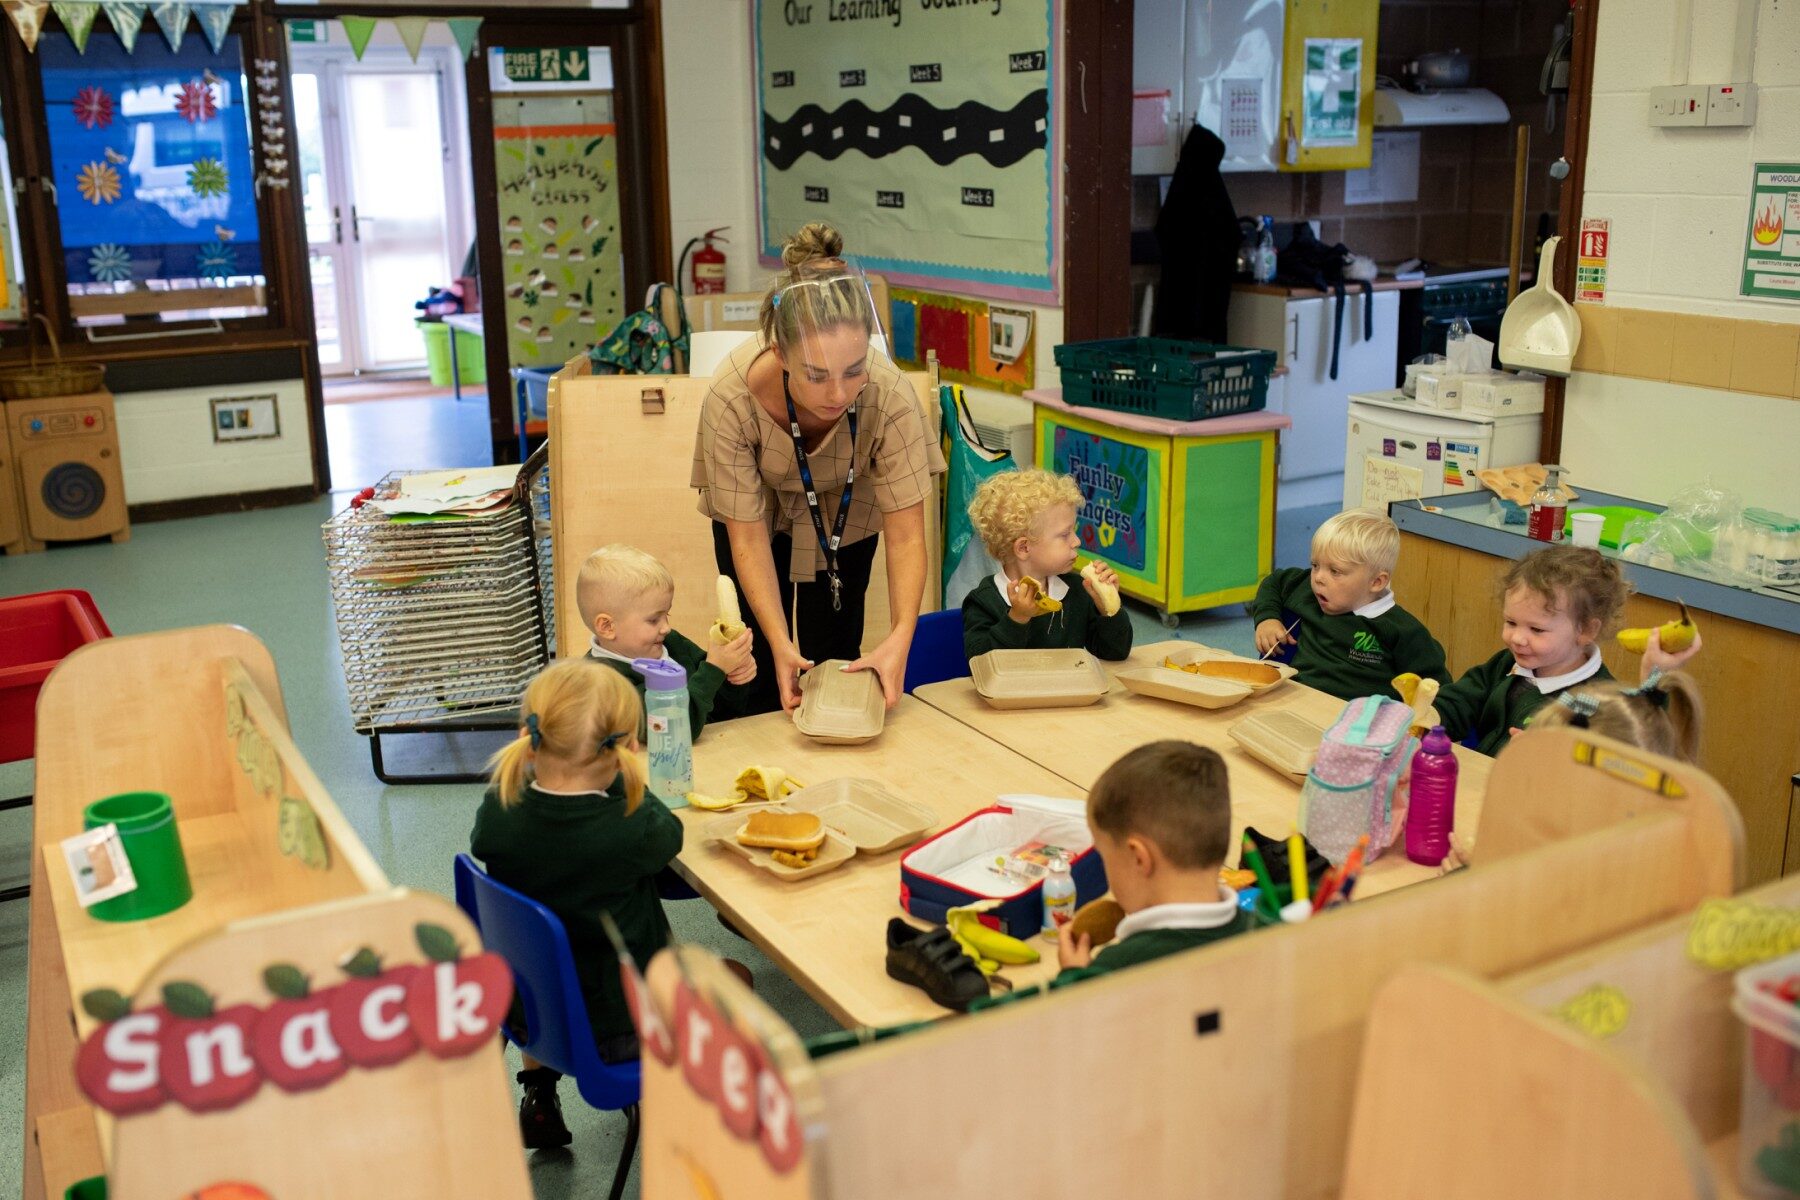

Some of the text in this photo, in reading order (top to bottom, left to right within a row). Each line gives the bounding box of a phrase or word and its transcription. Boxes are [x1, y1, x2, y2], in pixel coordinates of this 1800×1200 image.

[784, 0, 812, 26] Our
[828, 0, 902, 27] Learning
[504, 53, 537, 65] FIRE
[1010, 53, 1044, 71] Week 7
[506, 65, 537, 78] EXIT
[911, 65, 940, 81] Week 5
[1310, 116, 1352, 130] First aid
[963, 188, 993, 205] Week 6
[1070, 456, 1125, 501] Funky
[1077, 500, 1131, 533] ngers
[103, 960, 488, 1093] Snack
